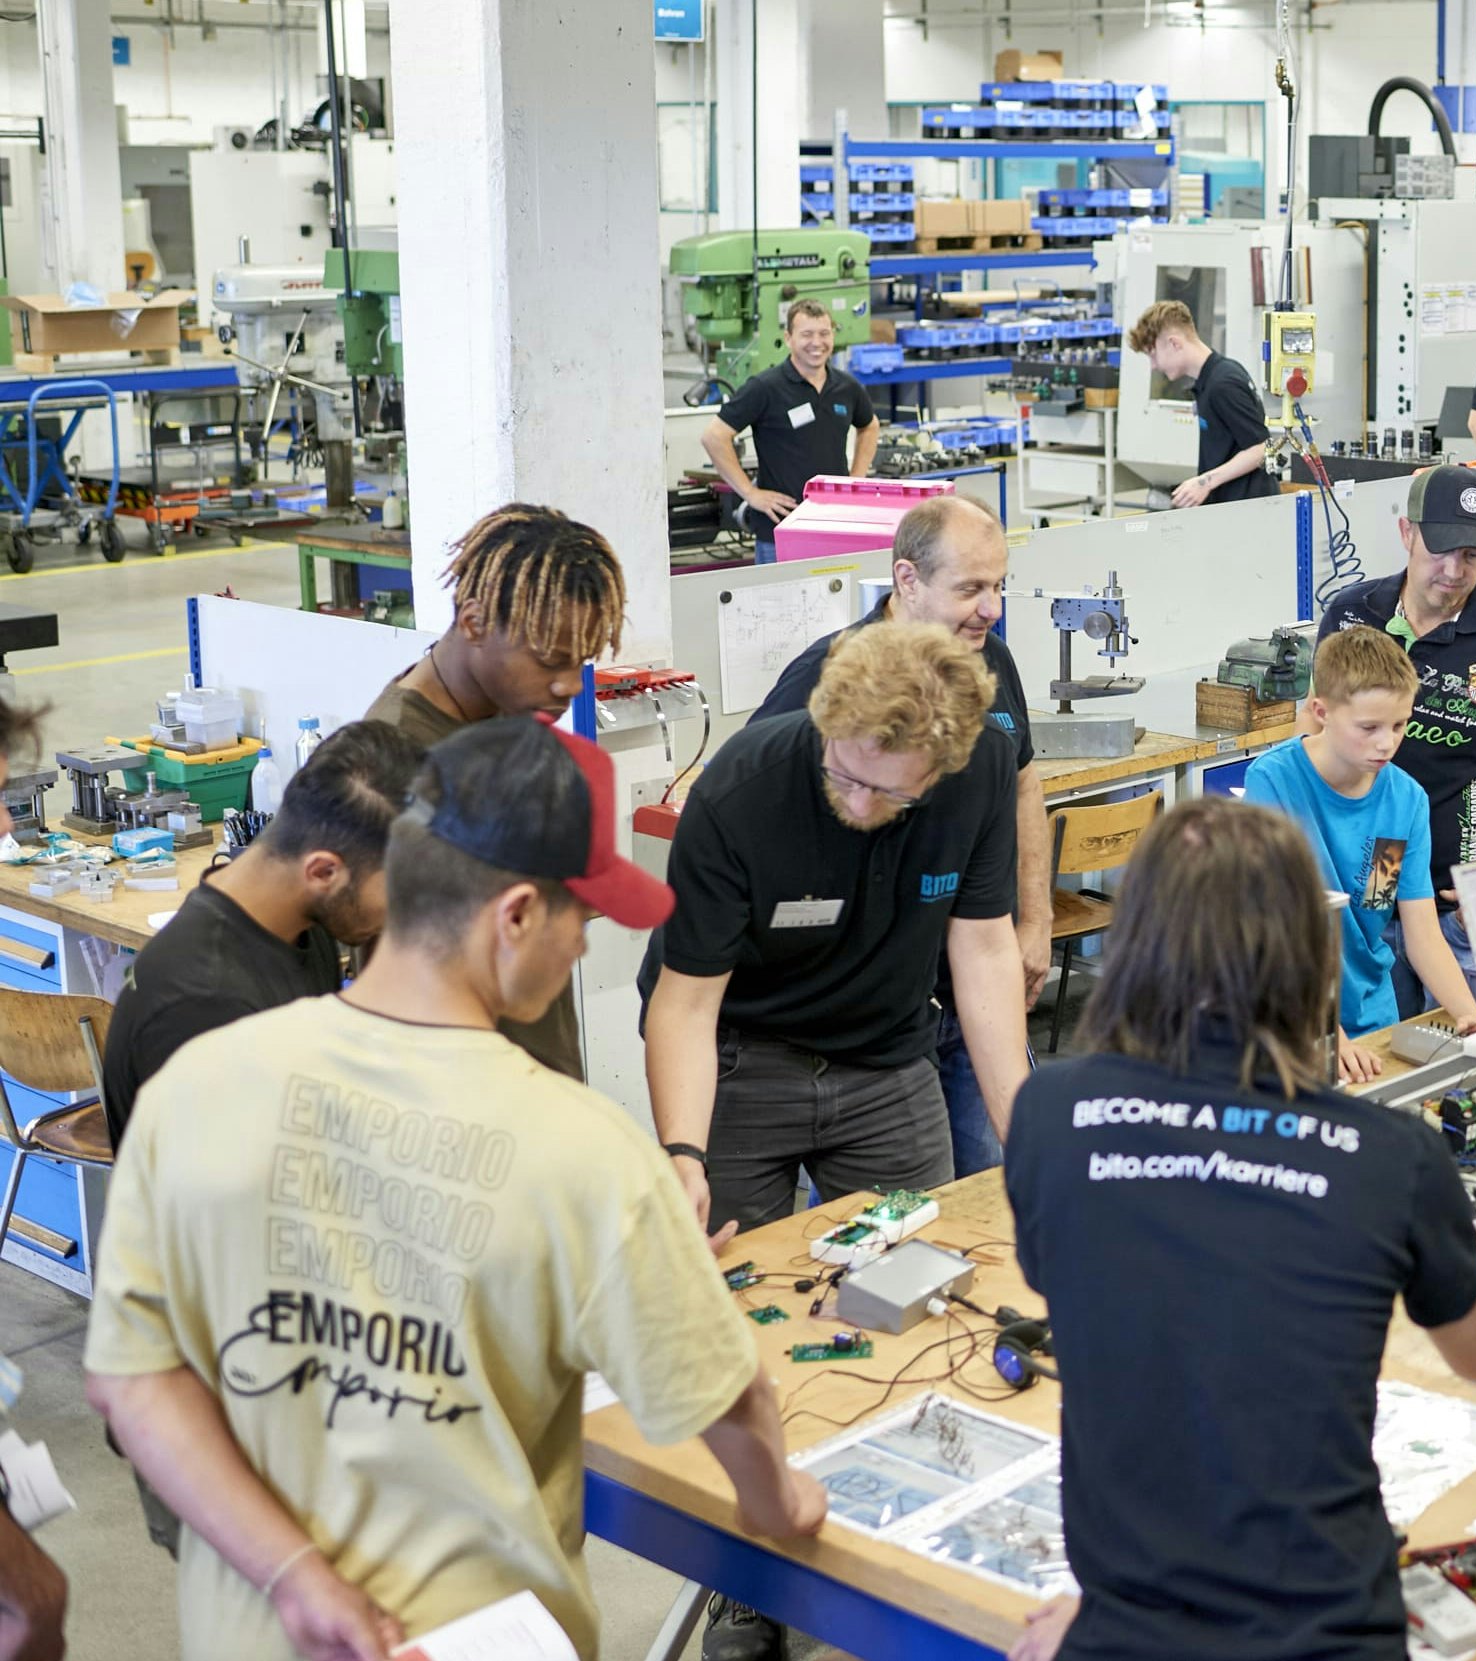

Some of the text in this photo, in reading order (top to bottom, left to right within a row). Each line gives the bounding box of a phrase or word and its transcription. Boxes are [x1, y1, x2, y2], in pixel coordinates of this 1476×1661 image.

[920, 872, 959, 896] BITO
[1354, 836, 1375, 886] Angeles
[281, 1073, 517, 1191] EMPORIO
[1073, 1097, 1360, 1153] BECOME A BIT OF US
[1088, 1150, 1328, 1198] bito.com/karriere
[269, 1143, 495, 1262] EMPORIO
